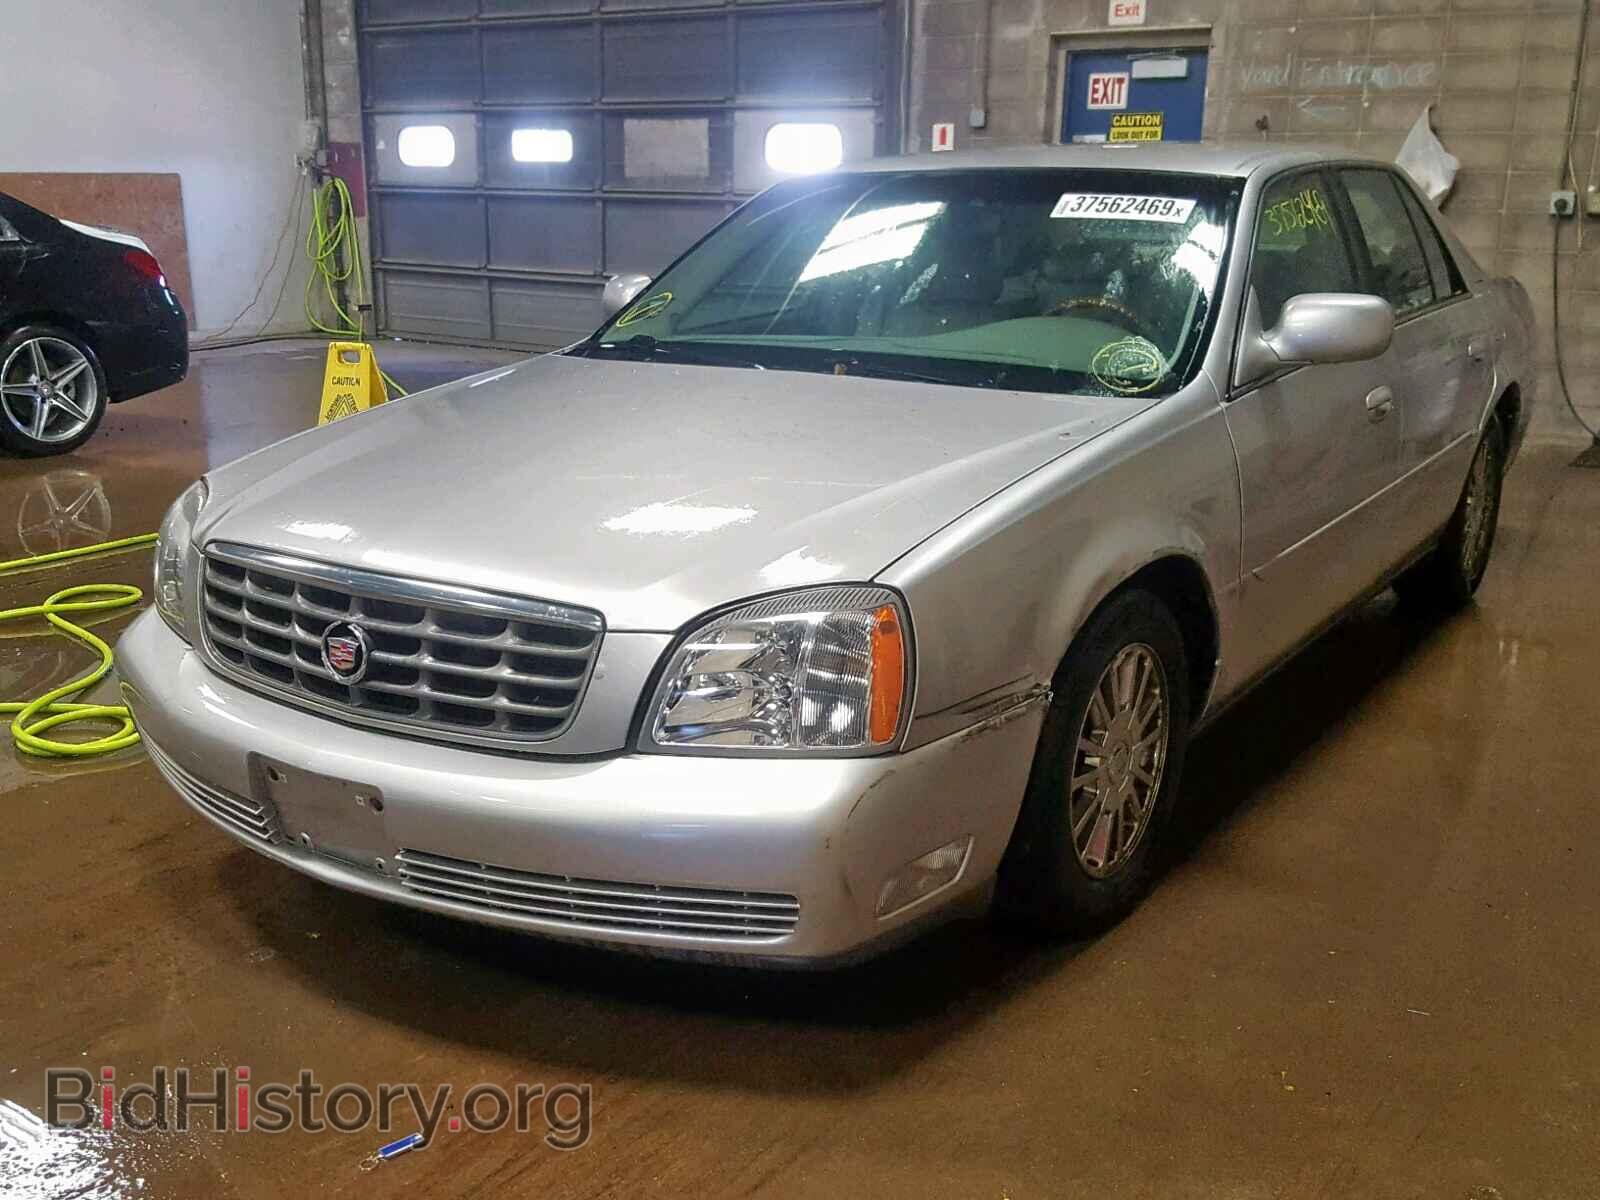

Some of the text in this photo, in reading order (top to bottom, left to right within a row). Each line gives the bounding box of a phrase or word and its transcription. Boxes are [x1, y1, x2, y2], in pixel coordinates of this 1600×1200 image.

[1114, 3, 1140, 17] Exit
[1090, 77, 1126, 105] EXIT
[1113, 114, 1160, 126] CAUTION
